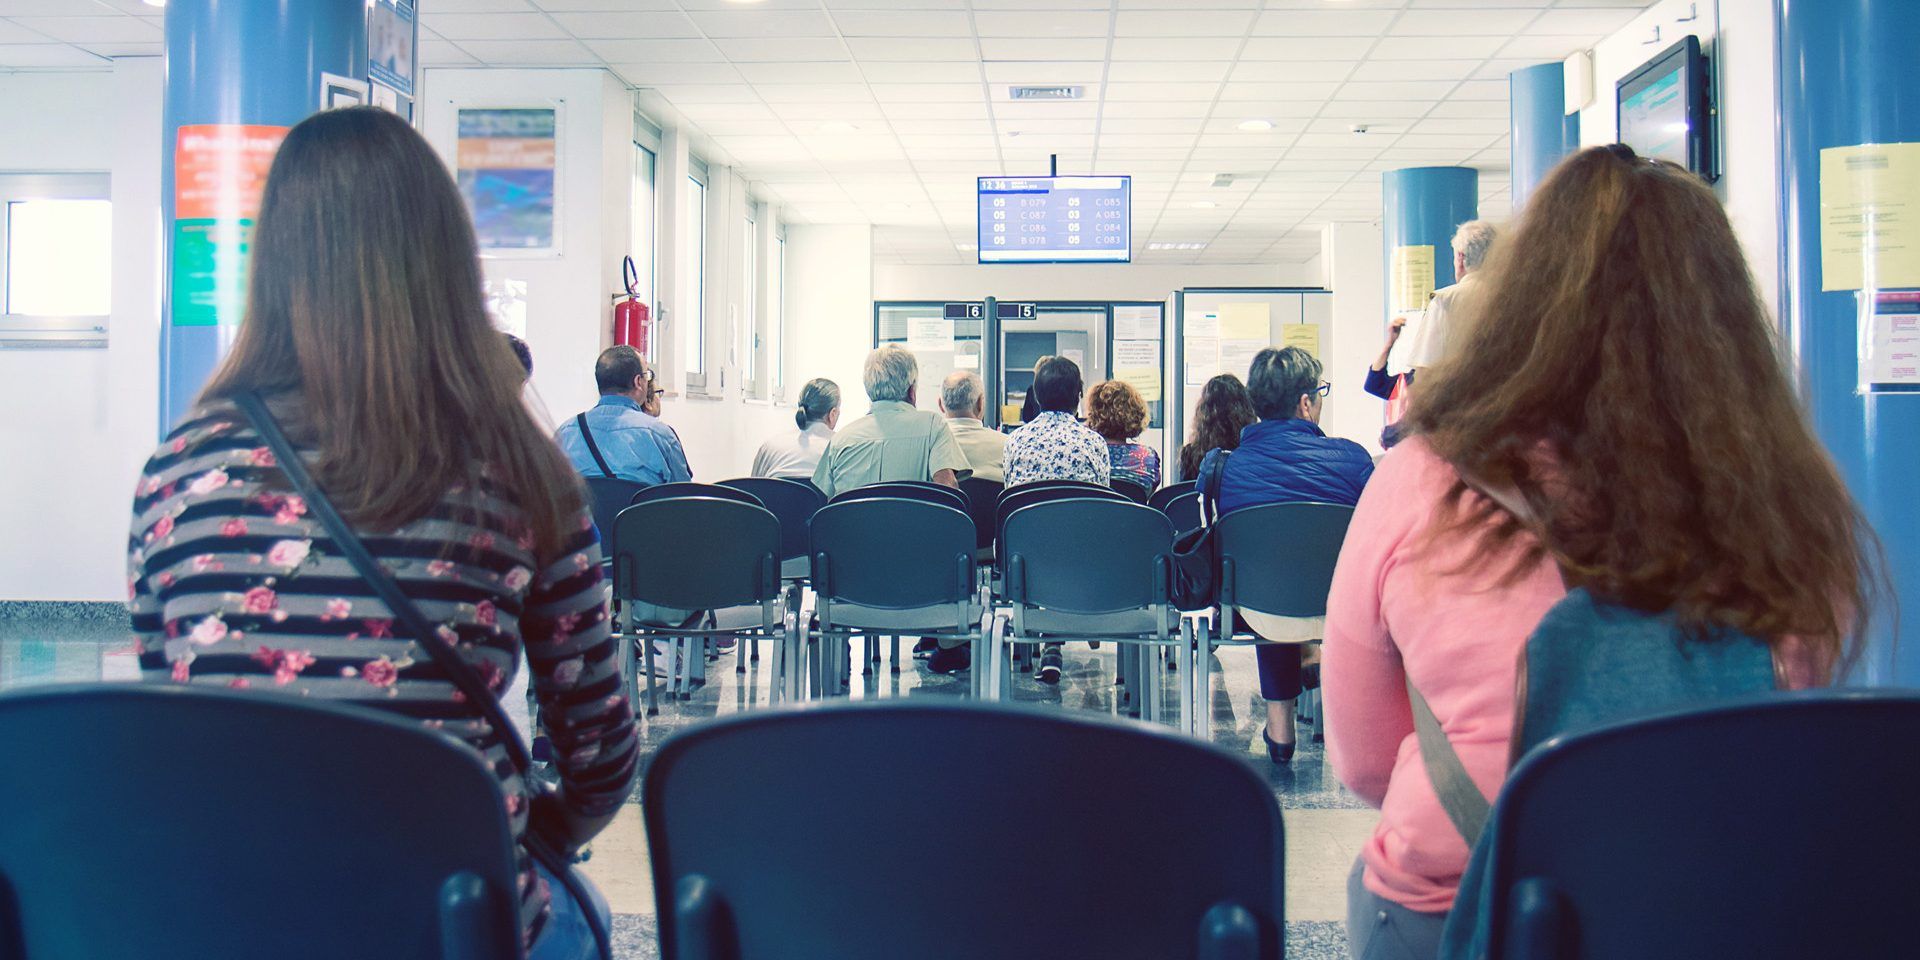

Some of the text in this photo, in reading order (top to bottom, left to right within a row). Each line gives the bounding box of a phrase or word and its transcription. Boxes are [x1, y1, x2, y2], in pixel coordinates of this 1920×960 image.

[1095, 198, 1102, 206] C
[1095, 211, 1102, 219] A
[1095, 236, 1102, 244] C
[971, 306, 979, 317] 6
[1023, 306, 1031, 317] 5
